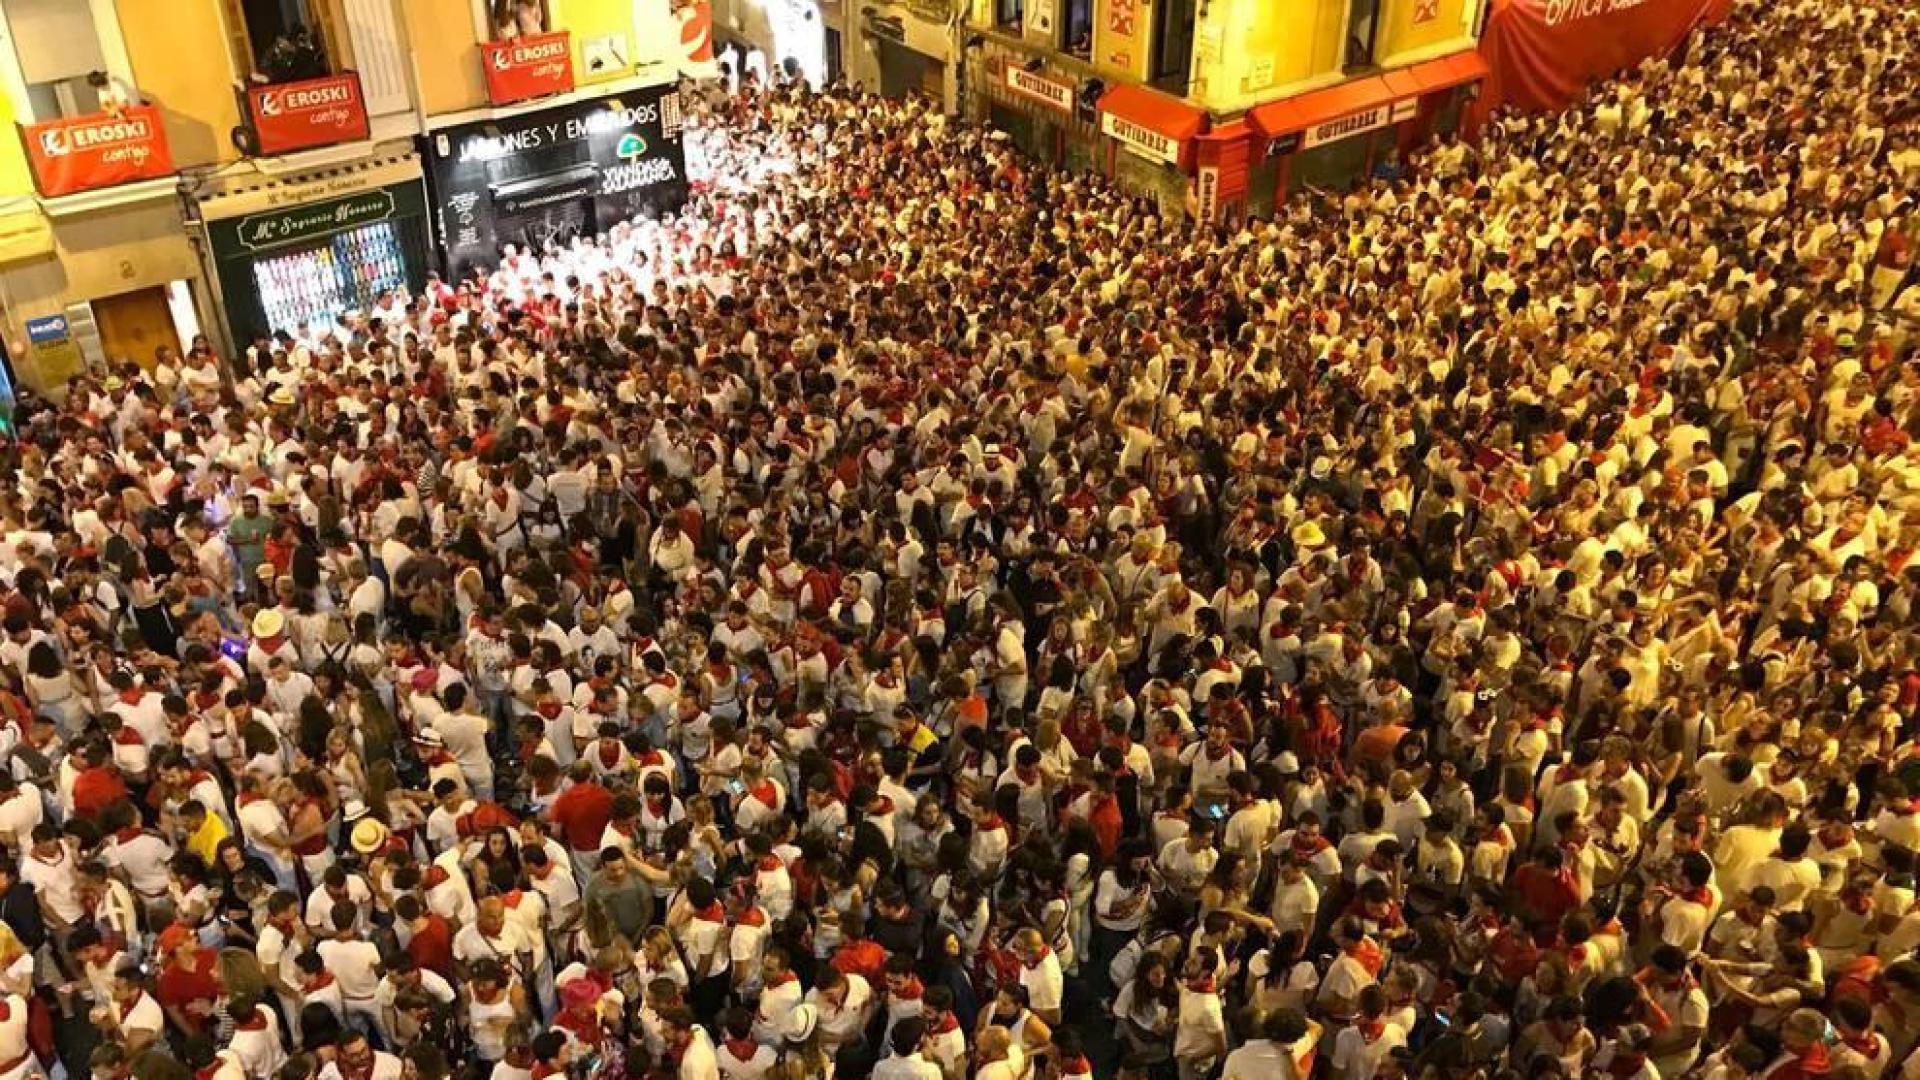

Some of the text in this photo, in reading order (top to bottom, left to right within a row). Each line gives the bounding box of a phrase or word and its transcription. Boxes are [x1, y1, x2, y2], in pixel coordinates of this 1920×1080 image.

[515, 42, 564, 63] EROSKI
[287, 86, 348, 108] EROSKI
[310, 104, 350, 128] contigo
[73, 121, 146, 147] EROSKI
[459, 127, 541, 162] JONES
[546, 123, 559, 144] Y
[565, 103, 658, 139] EMDOS
[102, 143, 150, 167] contigo
